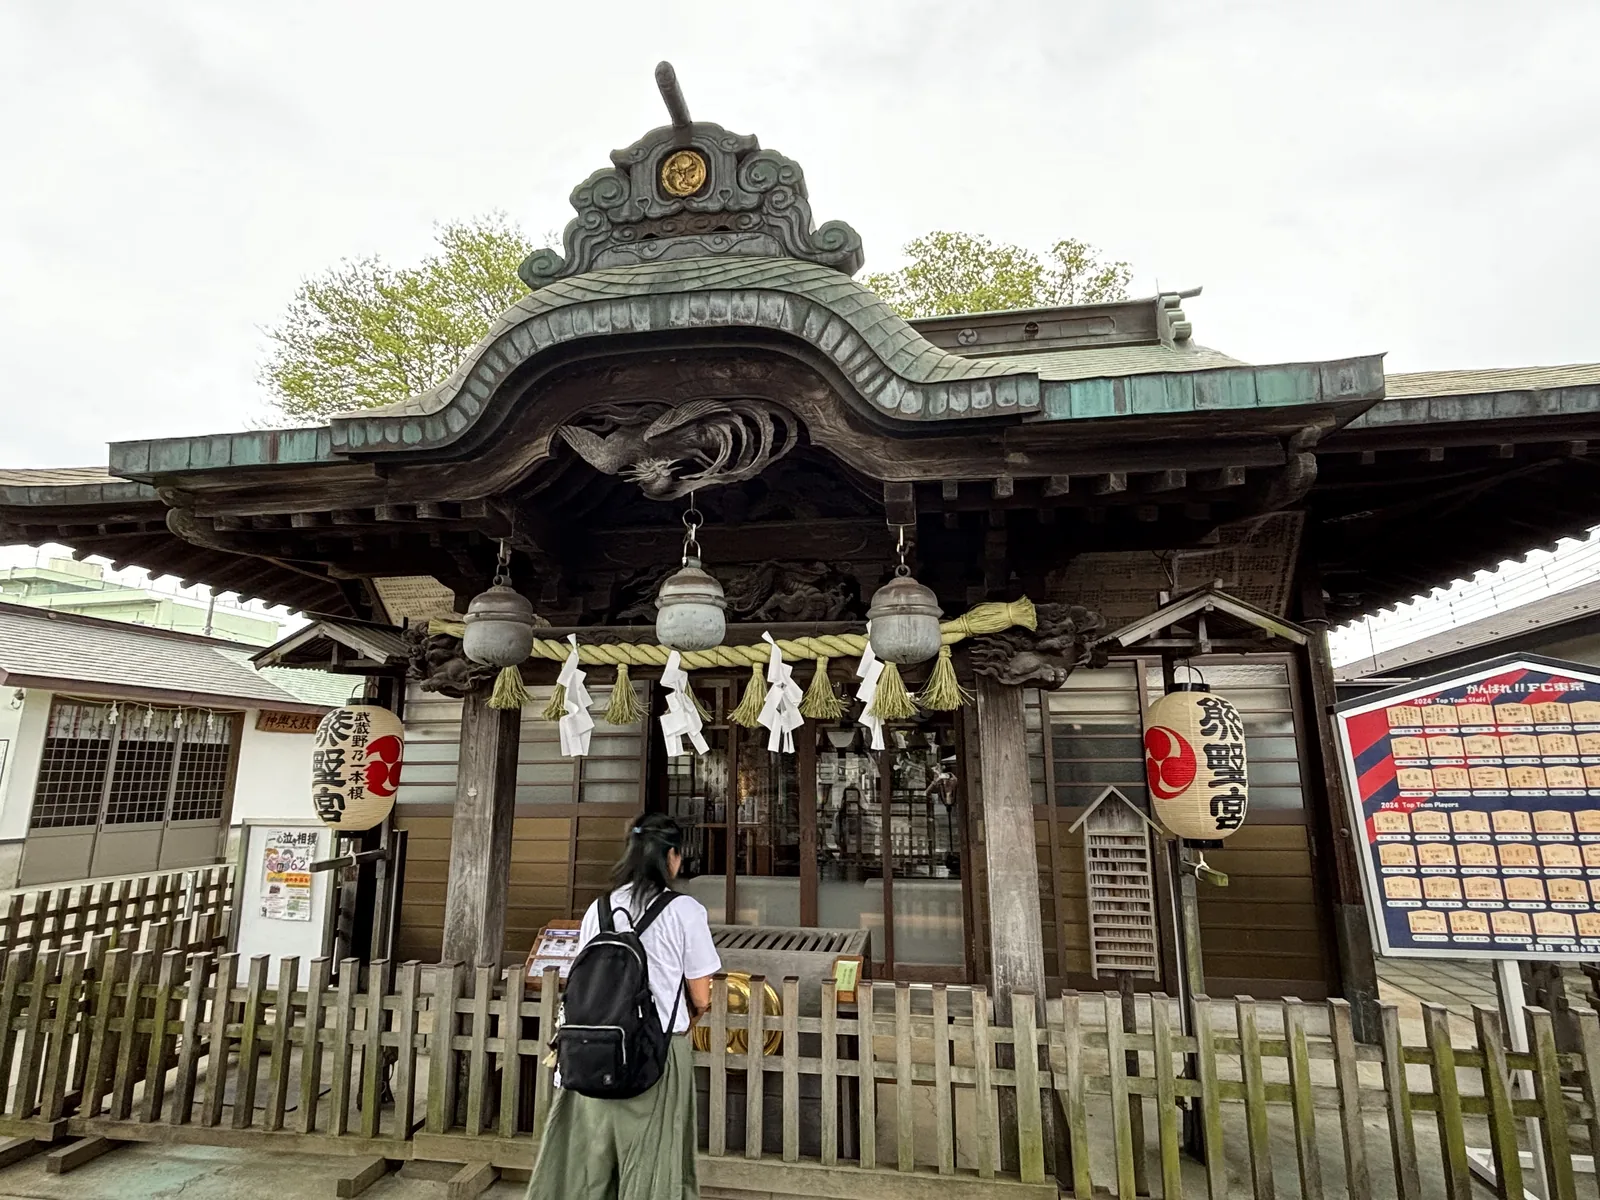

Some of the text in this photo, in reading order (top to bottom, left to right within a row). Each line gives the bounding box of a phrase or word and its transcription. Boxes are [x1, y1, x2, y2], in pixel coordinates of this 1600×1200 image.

[1527, 682, 1586, 692] FC東京
[347, 712, 371, 800] 武蔵野乃一本榎
